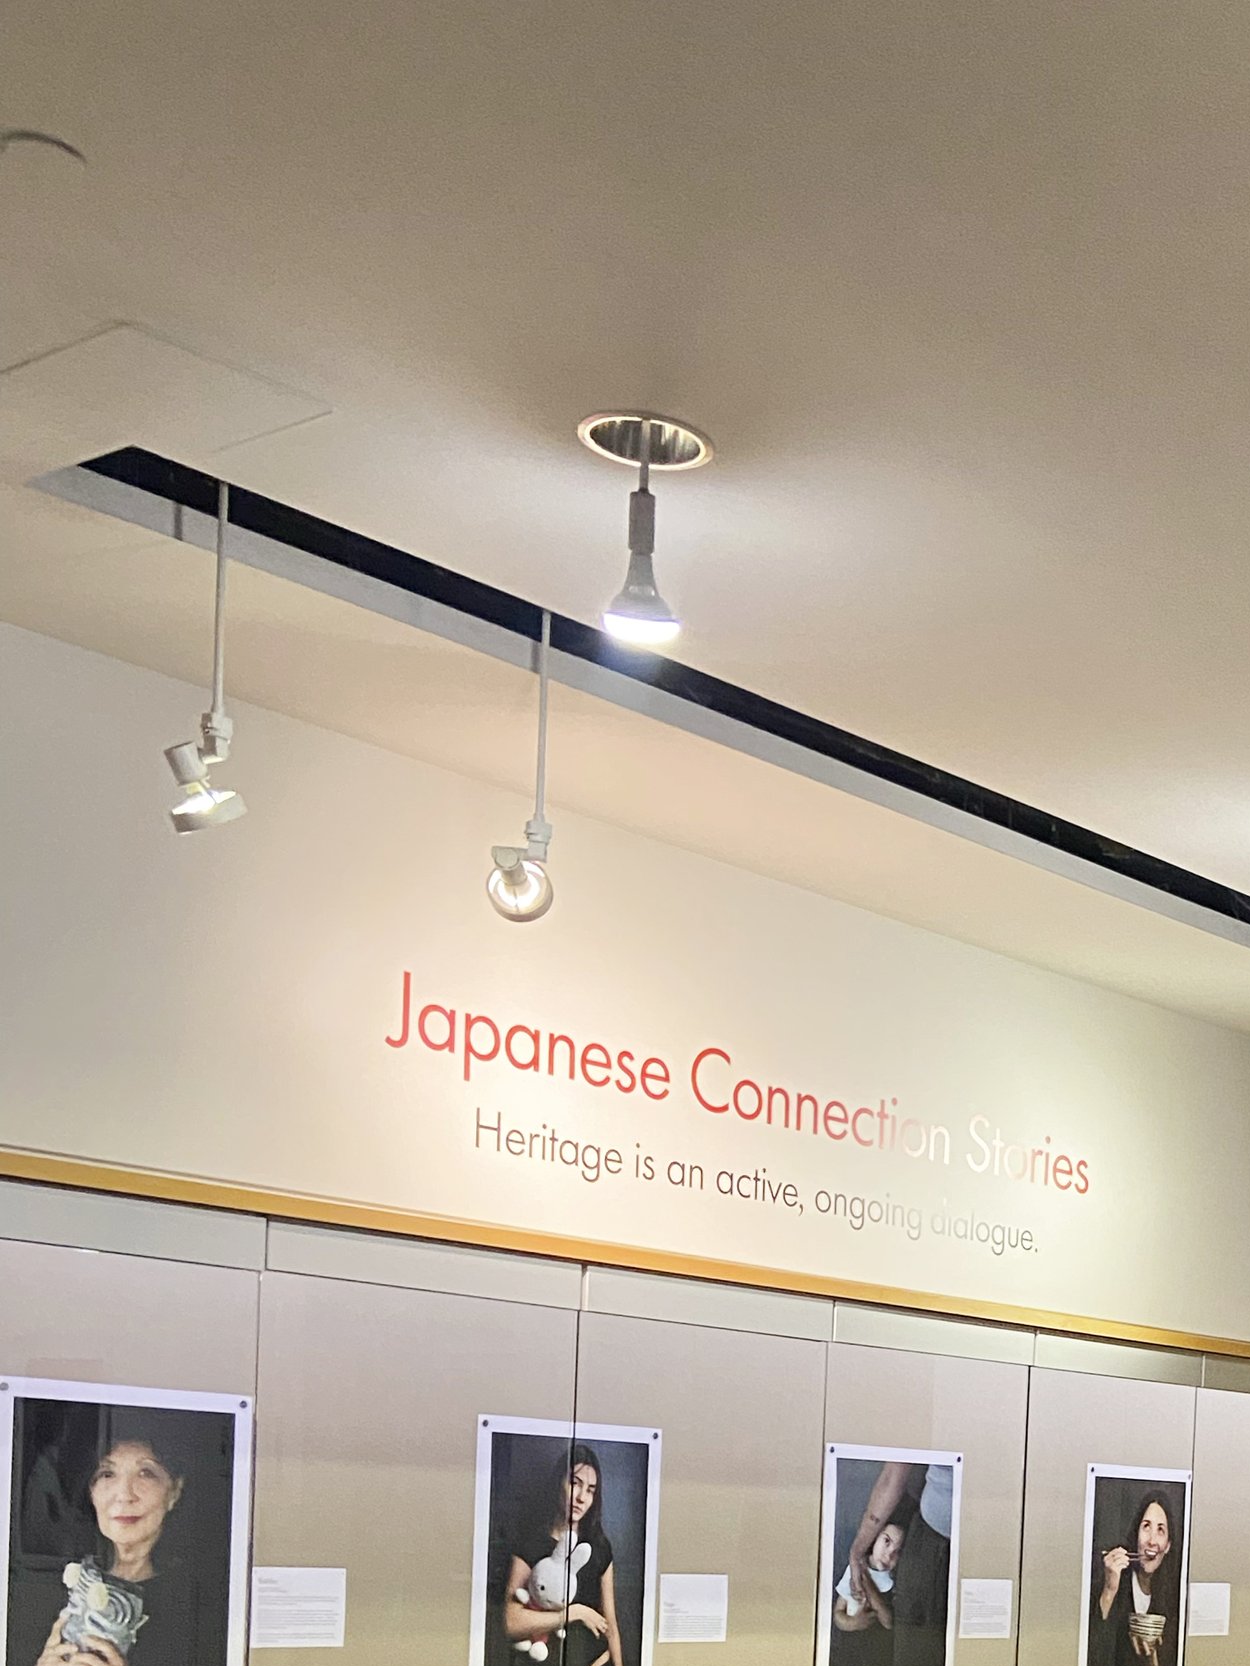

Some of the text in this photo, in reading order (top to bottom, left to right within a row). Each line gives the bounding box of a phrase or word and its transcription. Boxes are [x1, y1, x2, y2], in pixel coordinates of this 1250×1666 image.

[385, 971, 1091, 1195] Japanese Connection Stories
[475, 1107, 1039, 1257] Heritage is an active, ongoing dialogue.
